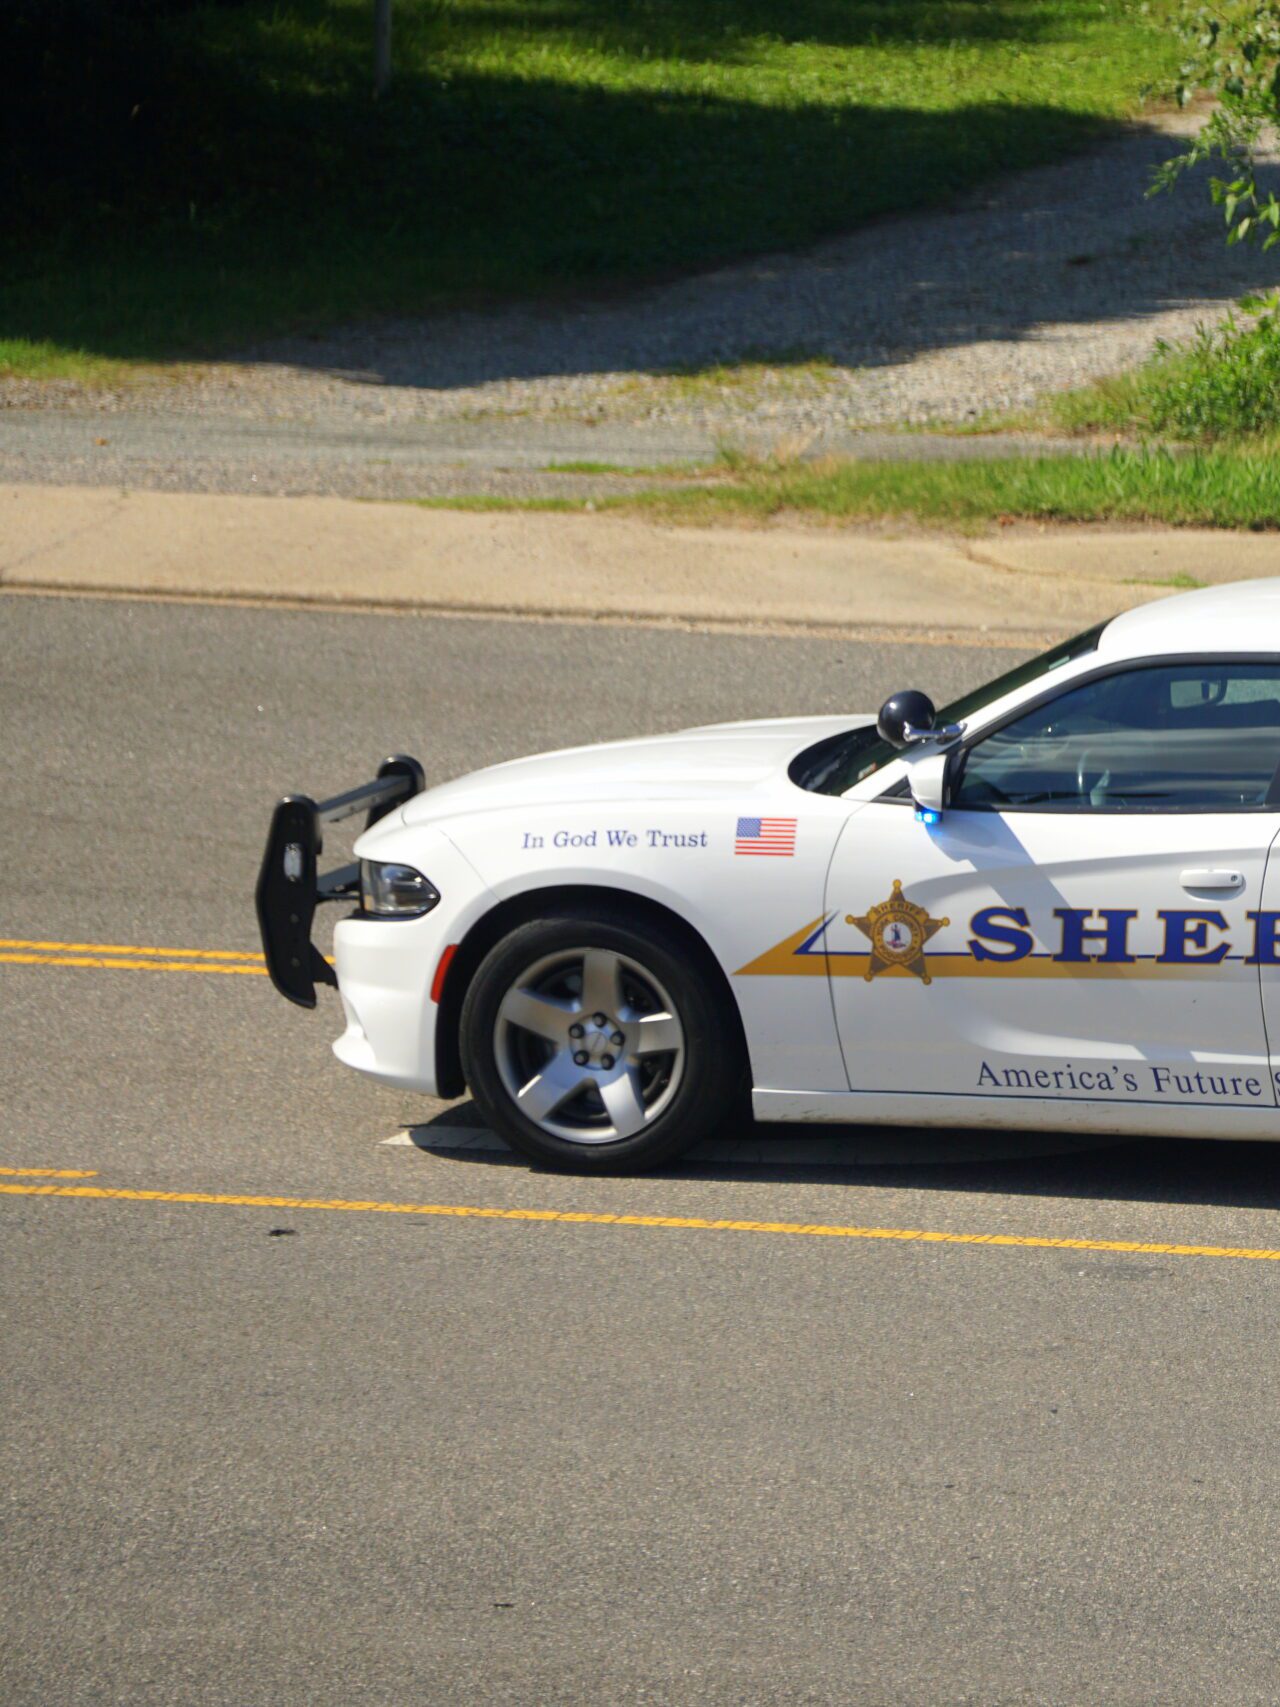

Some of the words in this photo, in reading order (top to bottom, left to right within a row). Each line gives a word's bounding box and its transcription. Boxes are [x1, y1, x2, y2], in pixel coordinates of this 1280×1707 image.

[521, 832, 545, 849] In
[553, 830, 598, 848] God
[606, 830, 638, 848] We
[646, 829, 708, 848] Trust
[976, 1060, 1139, 1093] America's
[1149, 1065, 1263, 1097] Future
